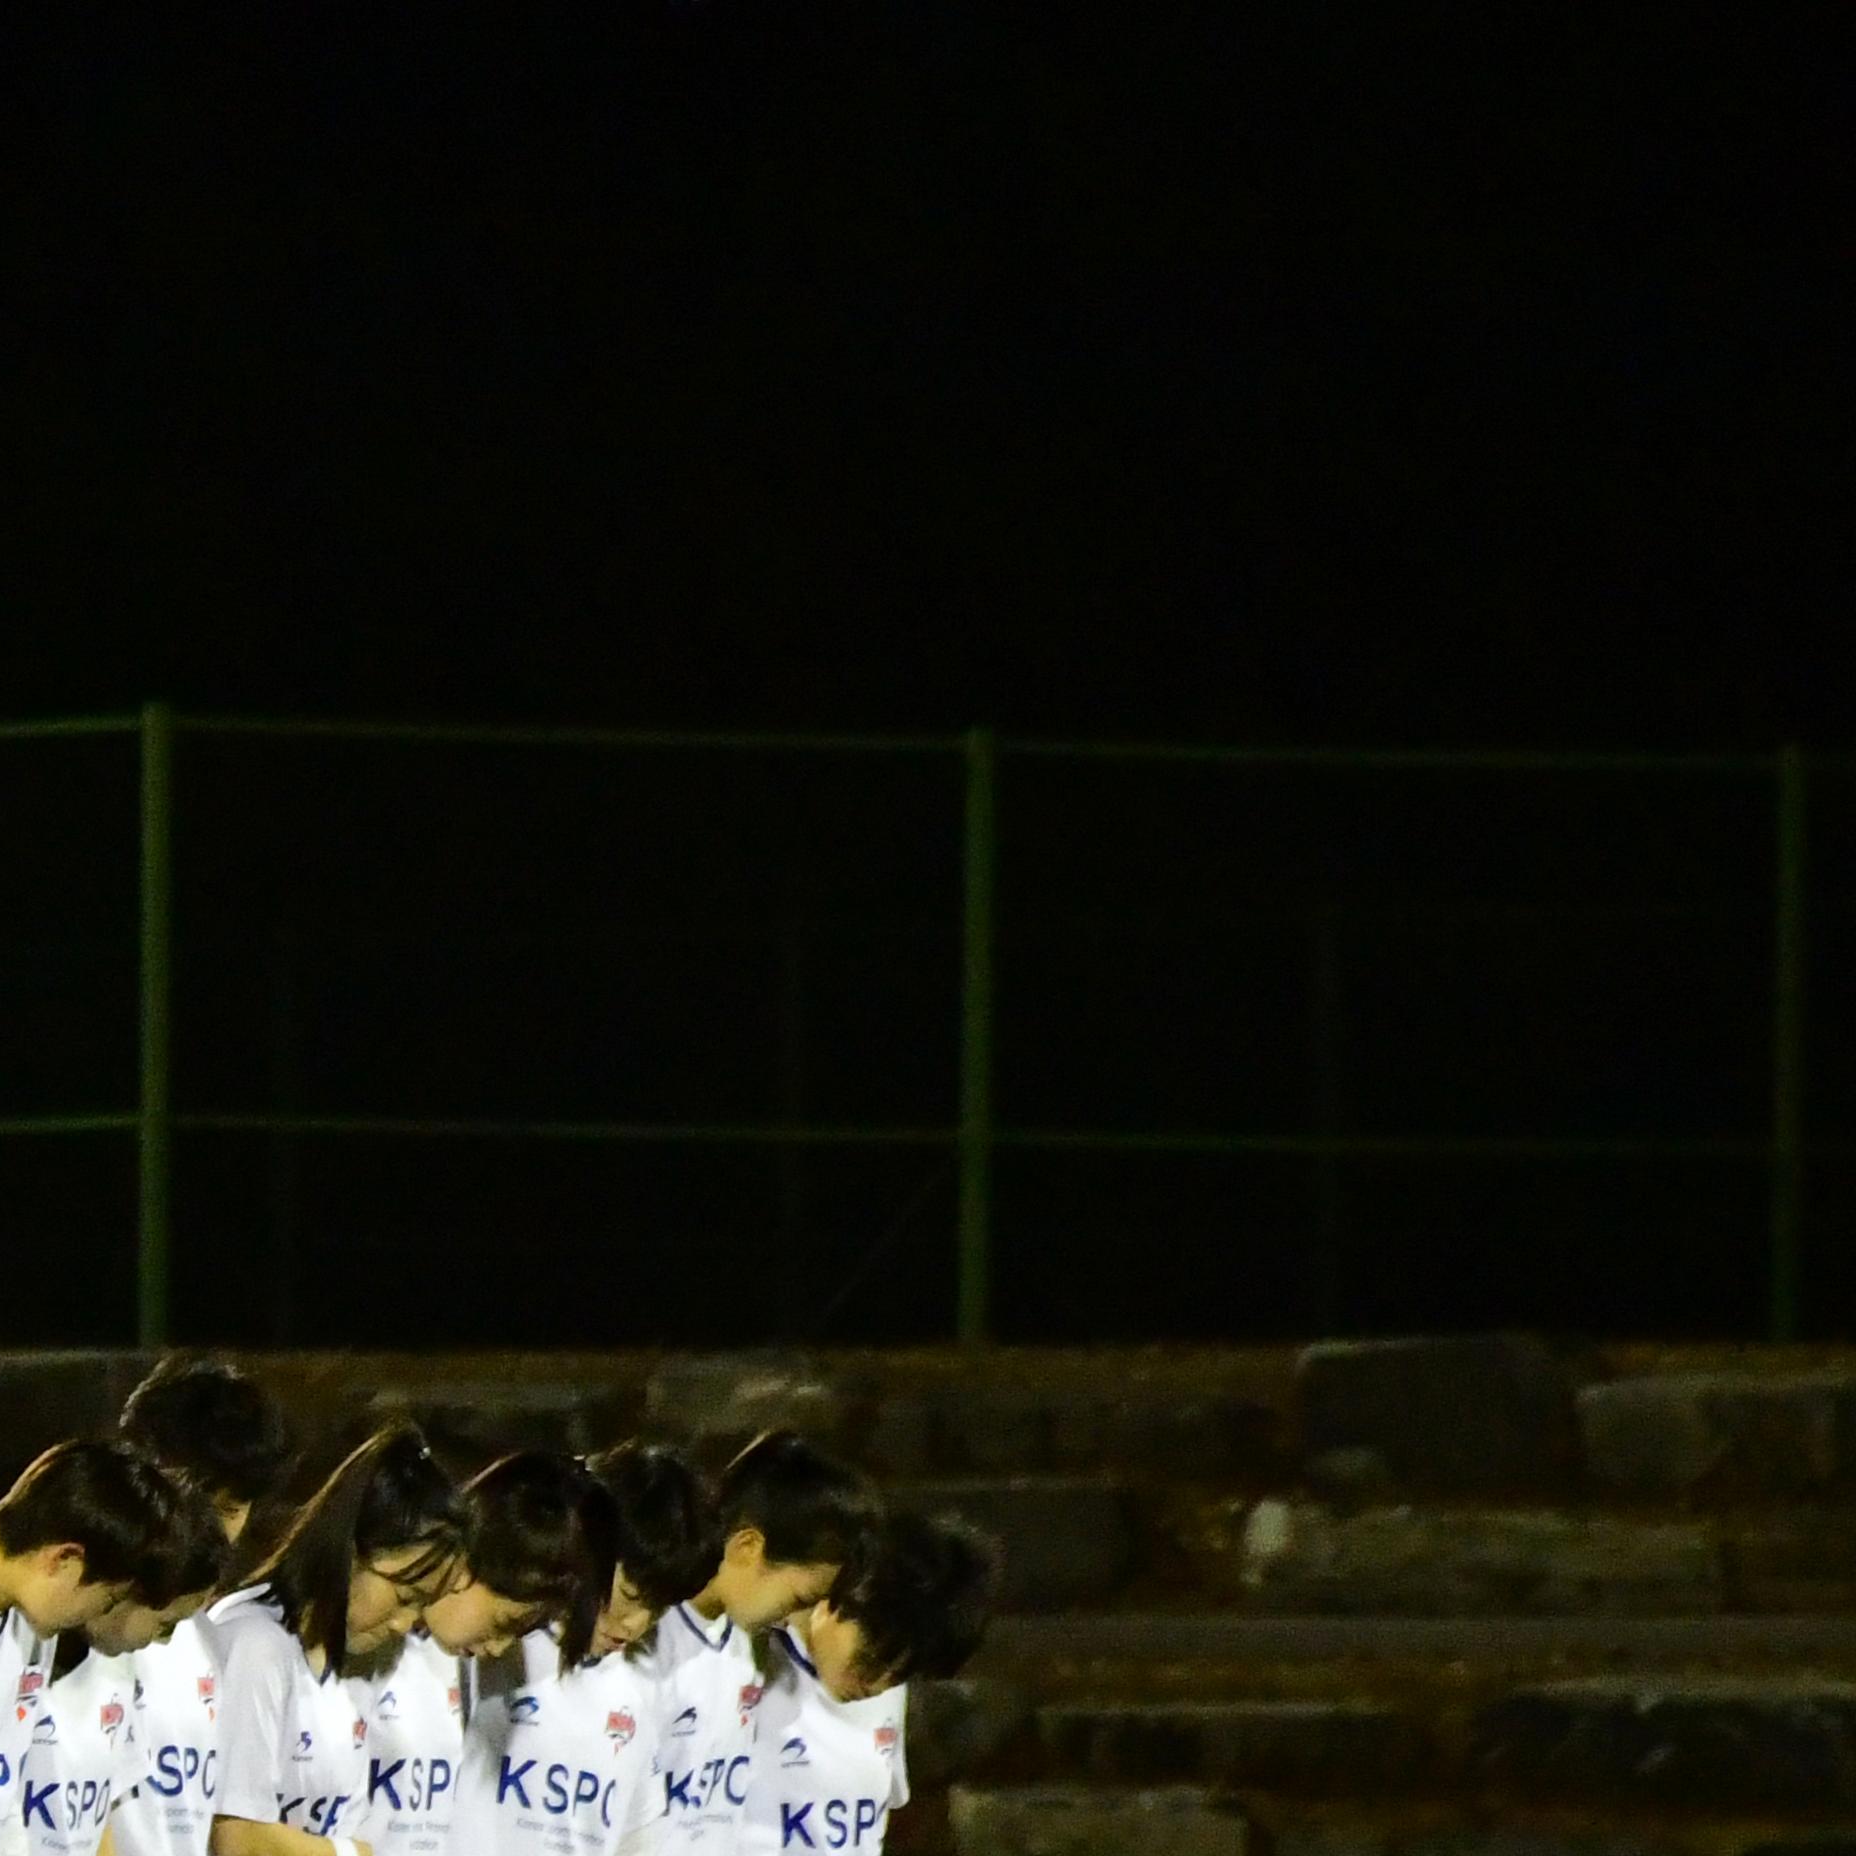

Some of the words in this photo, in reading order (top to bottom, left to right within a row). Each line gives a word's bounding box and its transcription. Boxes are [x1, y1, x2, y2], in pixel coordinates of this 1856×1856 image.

[144, 1745, 217, 1797] SPO
[368, 1758, 462, 1812] KSP
[780, 1799, 888, 1849] KSP
